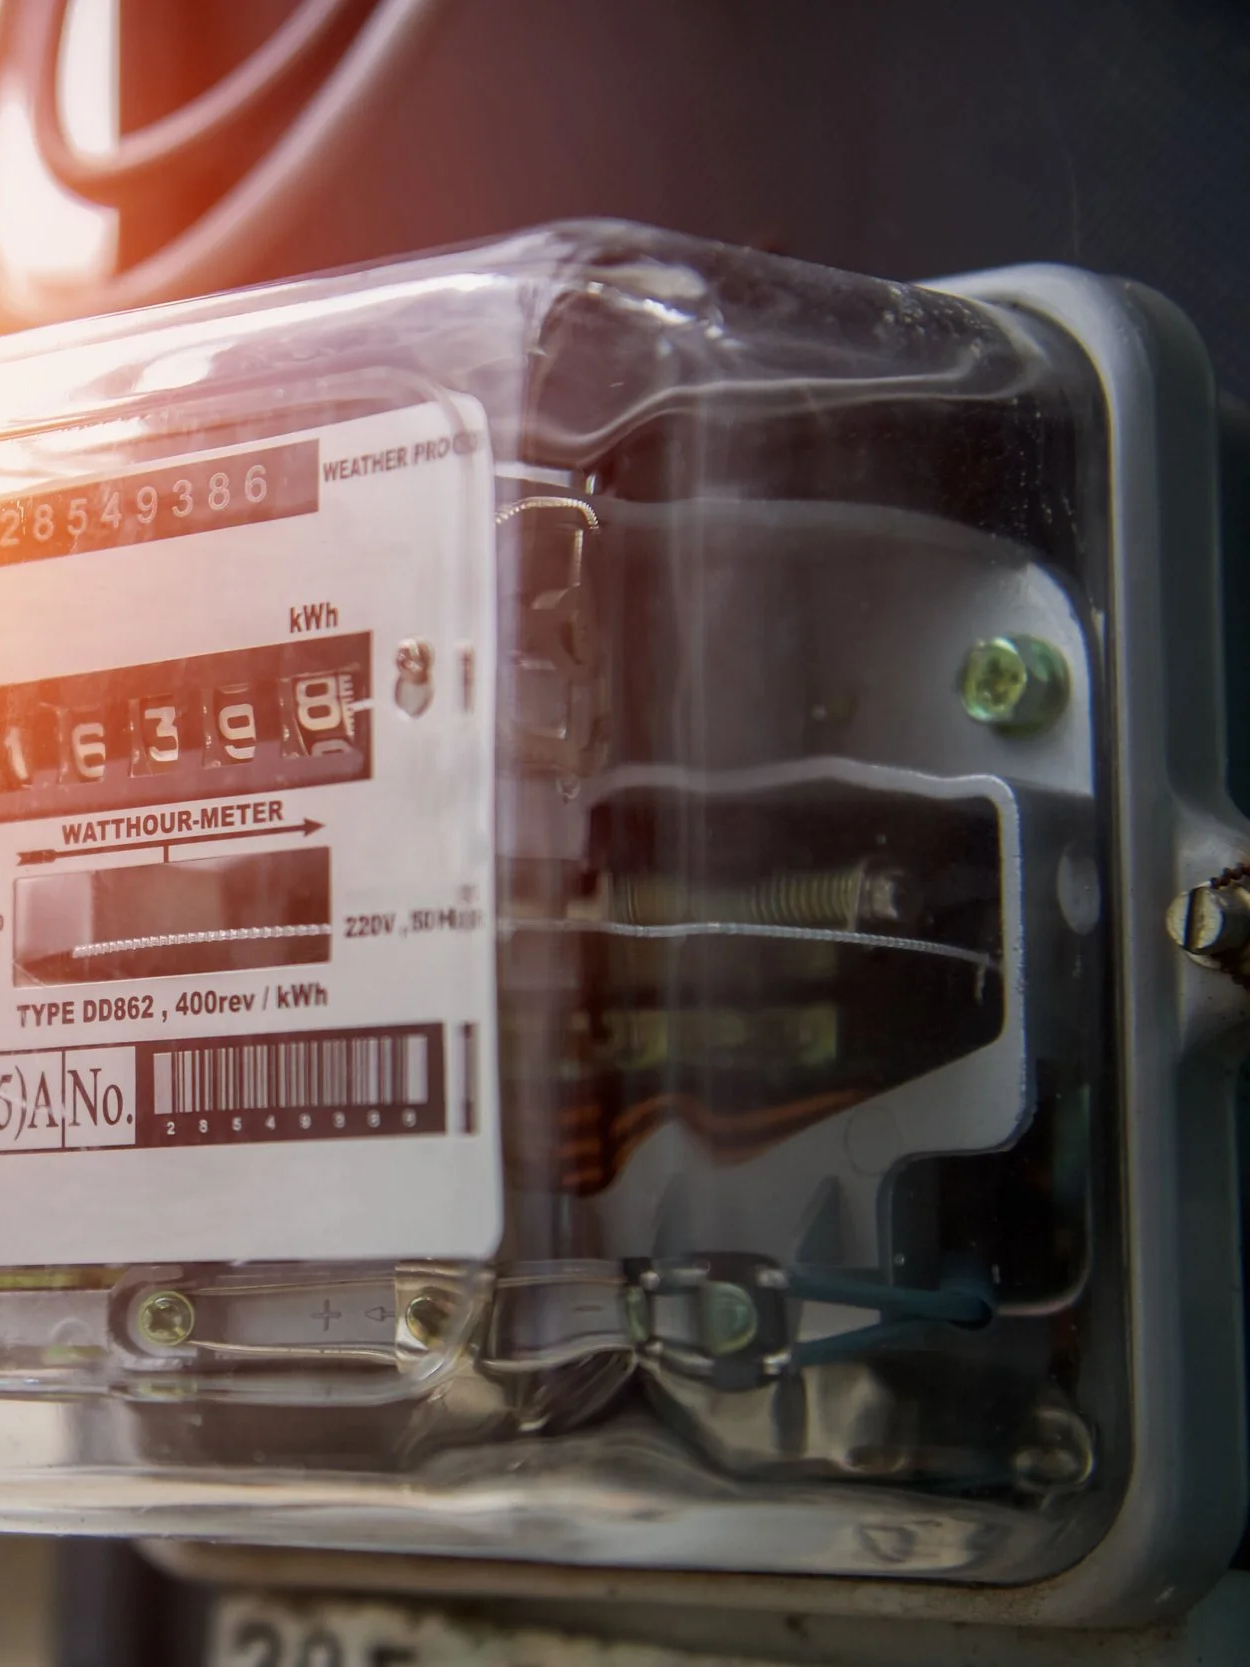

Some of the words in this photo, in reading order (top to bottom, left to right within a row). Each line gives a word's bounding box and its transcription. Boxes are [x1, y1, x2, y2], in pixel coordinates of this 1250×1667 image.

[323, 447, 407, 482] WEATHER
[414, 431, 478, 464] PRO
[0, 465, 267, 546] 28549386
[289, 602, 339, 632] kWh
[62, 800, 284, 845] WATTHOUR-METER
[345, 912, 396, 938] 220V
[17, 1001, 75, 1027] TYPE
[83, 995, 154, 1022] DD862
[175, 989, 255, 1015] 400rev
[277, 981, 328, 1009] kWh
[67, 1068, 133, 1126] No.
